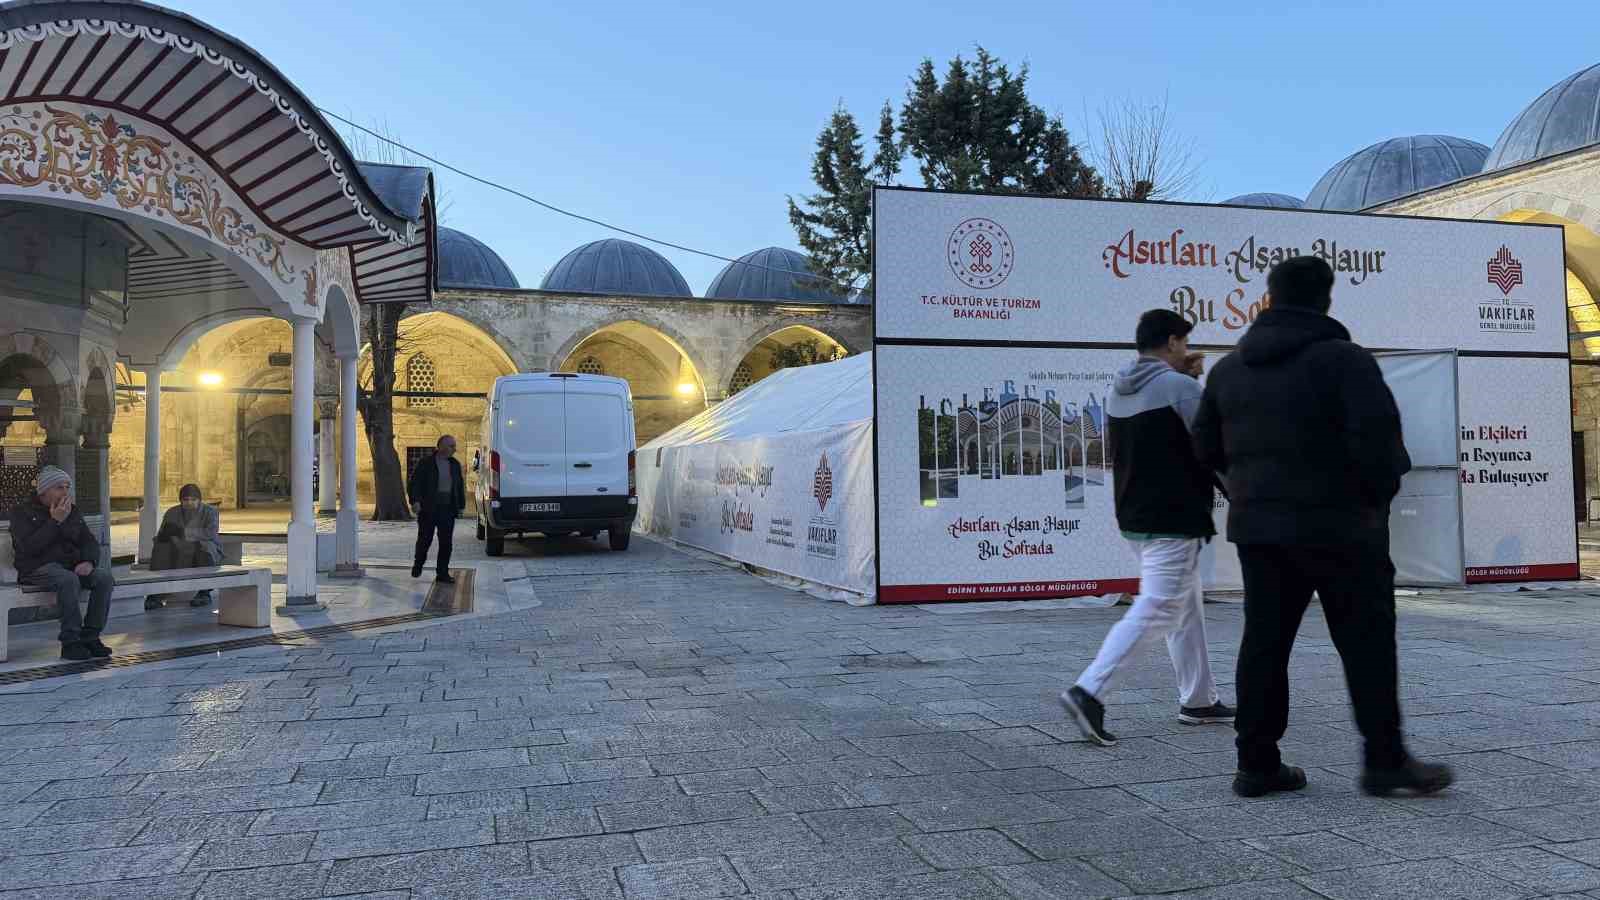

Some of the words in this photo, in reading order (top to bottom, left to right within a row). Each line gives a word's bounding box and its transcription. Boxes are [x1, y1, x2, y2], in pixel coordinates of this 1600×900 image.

[1102, 228, 1218, 279] Asırları
[942, 294, 983, 307] KÜLTÜR
[985, 298, 999, 307] VE
[1001, 297, 1041, 309] TURİZM
[953, 308, 1011, 320] BAKANLIĞI
[1478, 306, 1535, 321] VAKIFLAR
[1479, 425, 1528, 444] Elçileri
[1473, 447, 1532, 466] Boyunca
[1479, 469, 1550, 487] Buluşuyor
[808, 526, 838, 545] VAKIFLAR
[947, 515, 1001, 539] Asırları
[1003, 516, 1040, 538] Aşan
[1042, 515, 1081, 536] Hayır
[978, 540, 999, 560] Bu
[1002, 540, 1055, 558] Sofrada
[947, 586, 977, 595] EDİRNE
[979, 585, 1018, 594] VAKIFLAR
[1020, 583, 1047, 593] BÖLGE
[1048, 582, 1099, 592] MÜDÜRLÜĞÜ
